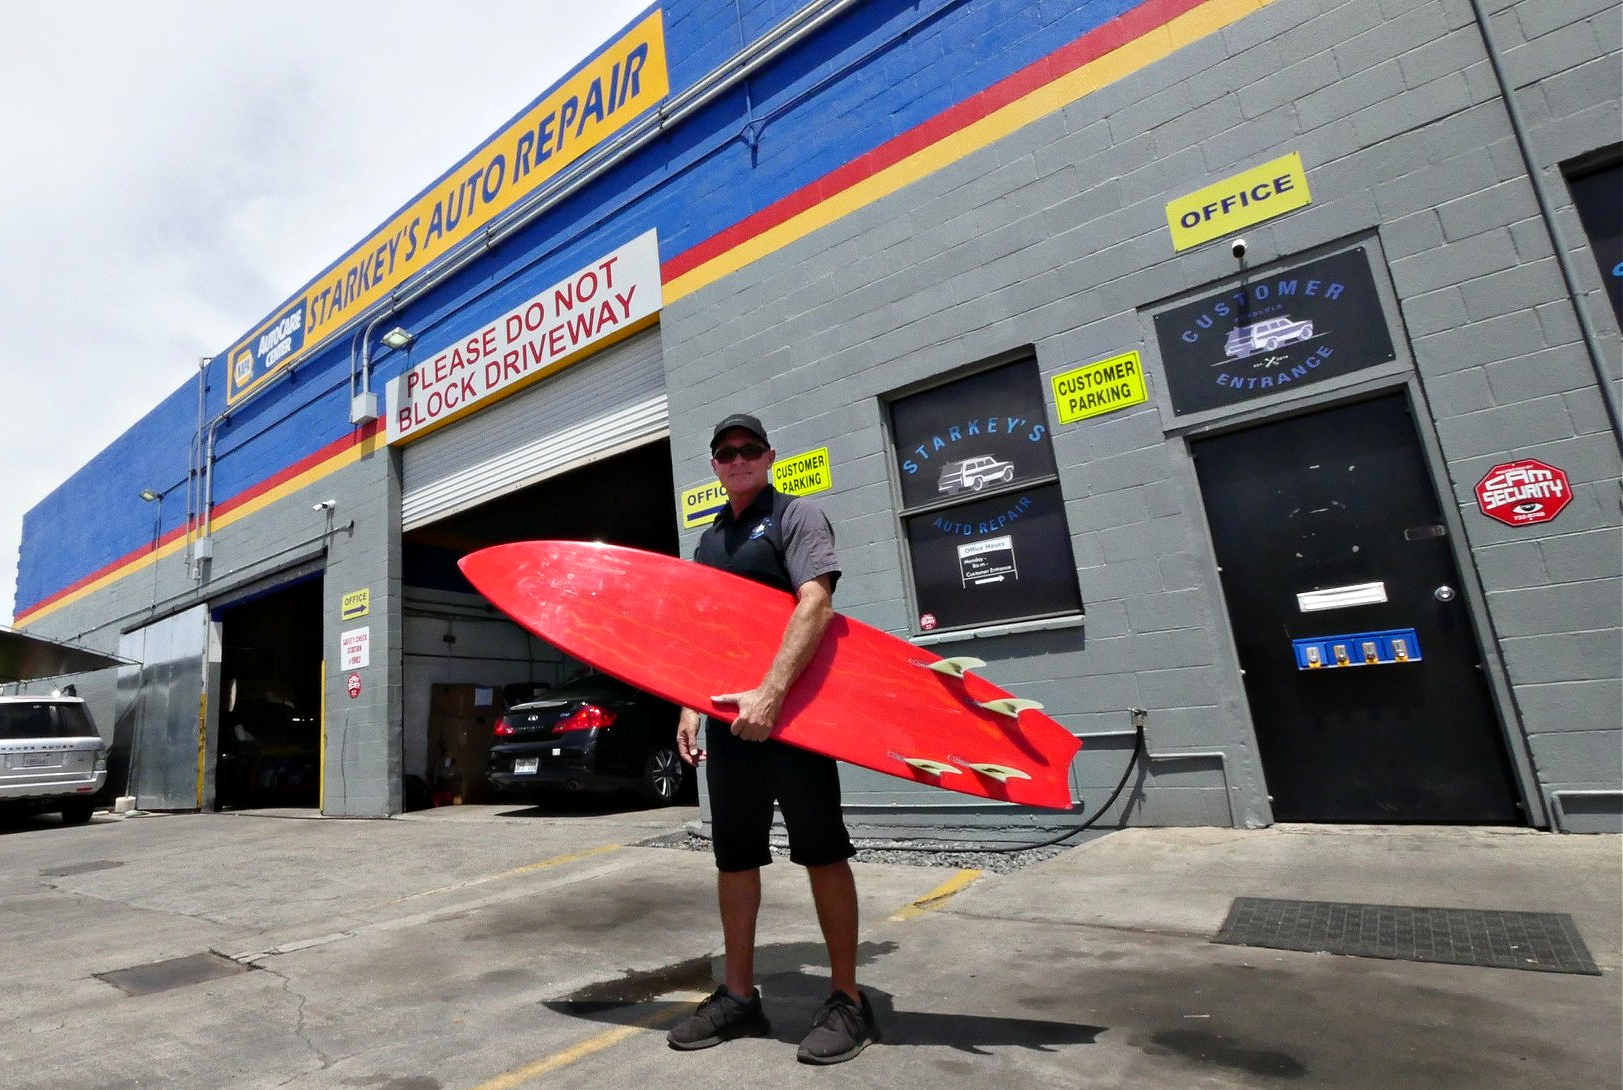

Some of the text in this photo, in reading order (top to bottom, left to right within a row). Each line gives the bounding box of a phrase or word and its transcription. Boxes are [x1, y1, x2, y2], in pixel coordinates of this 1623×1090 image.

[306, 42, 648, 334] STARKEY'S AUTO REPAIR
[1180, 174, 1294, 229] OFFICE
[406, 257, 618, 398] PLEASE DO NOT
[1182, 280, 1345, 343] CUSTOMER
[399, 285, 637, 434] BLOCK DRIVEWAY
[1058, 360, 1135, 396] CUSTOMER
[1216, 345, 1334, 389] ENTRANCE
[1069, 383, 1132, 414] PARKING
[902, 417, 1046, 475] STARKEY'S
[776, 455, 825, 480] CUSTOMER
[782, 473, 822, 493] PARKING
[1485, 469, 1553, 491] CAM
[687, 485, 728, 506] OFFIC
[1482, 479, 1563, 510] SECURITY
[933, 496, 1032, 536] AUTO REPAIR
[344, 592, 368, 606] OFFICE
